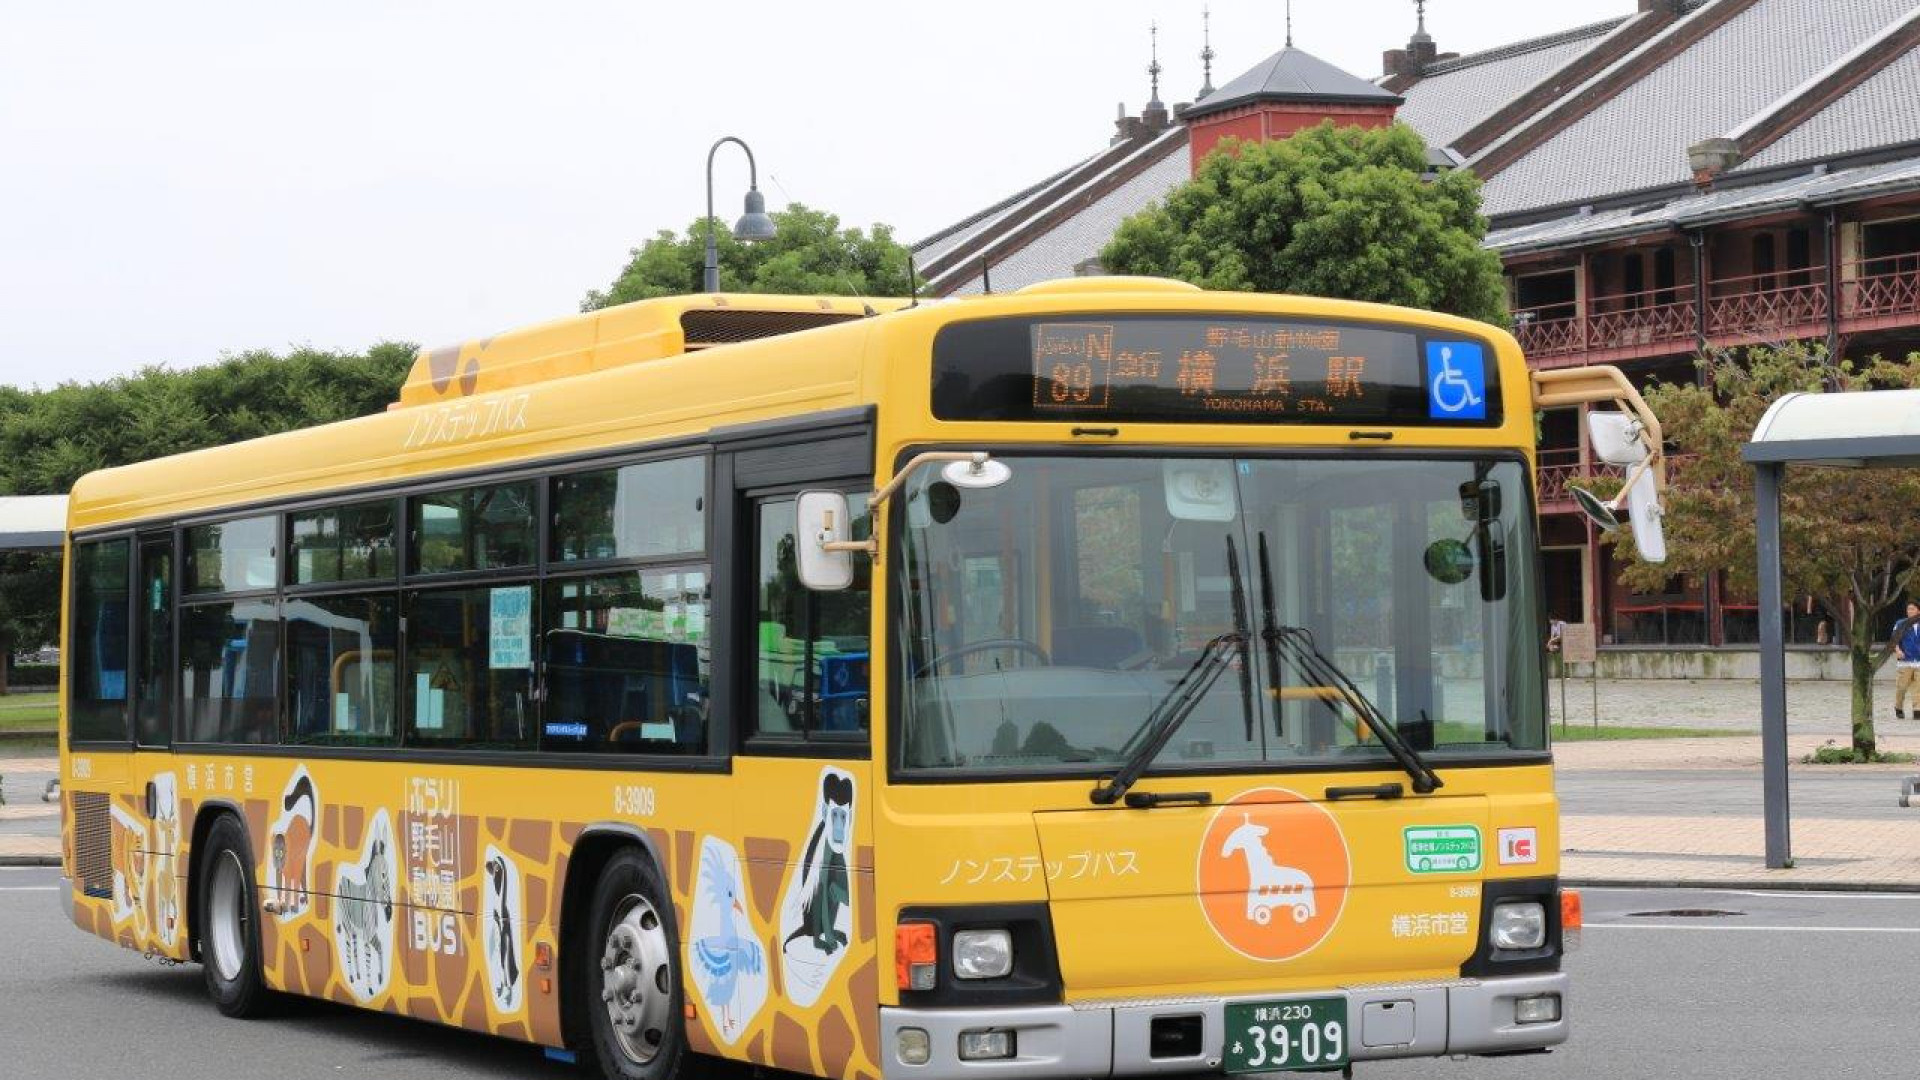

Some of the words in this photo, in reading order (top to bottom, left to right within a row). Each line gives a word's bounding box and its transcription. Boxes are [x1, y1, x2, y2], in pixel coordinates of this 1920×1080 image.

[1206, 327, 1341, 350] 野毛山動物園
[1115, 350, 1162, 377] 急行
[1051, 363, 1092, 401] 89
[1203, 399, 1285, 411] YOKOHAMA
[1297, 400, 1334, 413] STA.
[410, 777, 454, 818] ぶらり
[614, 785, 655, 816] 8-3909
[411, 821, 454, 867] 野毛山
[940, 850, 1140, 884] ノンステップバス
[414, 911, 457, 955] BUS
[1391, 911, 1468, 937] 横浜市営
[1282, 1004, 1312, 1020] 230
[1247, 1020, 1342, 1066] 39-09
